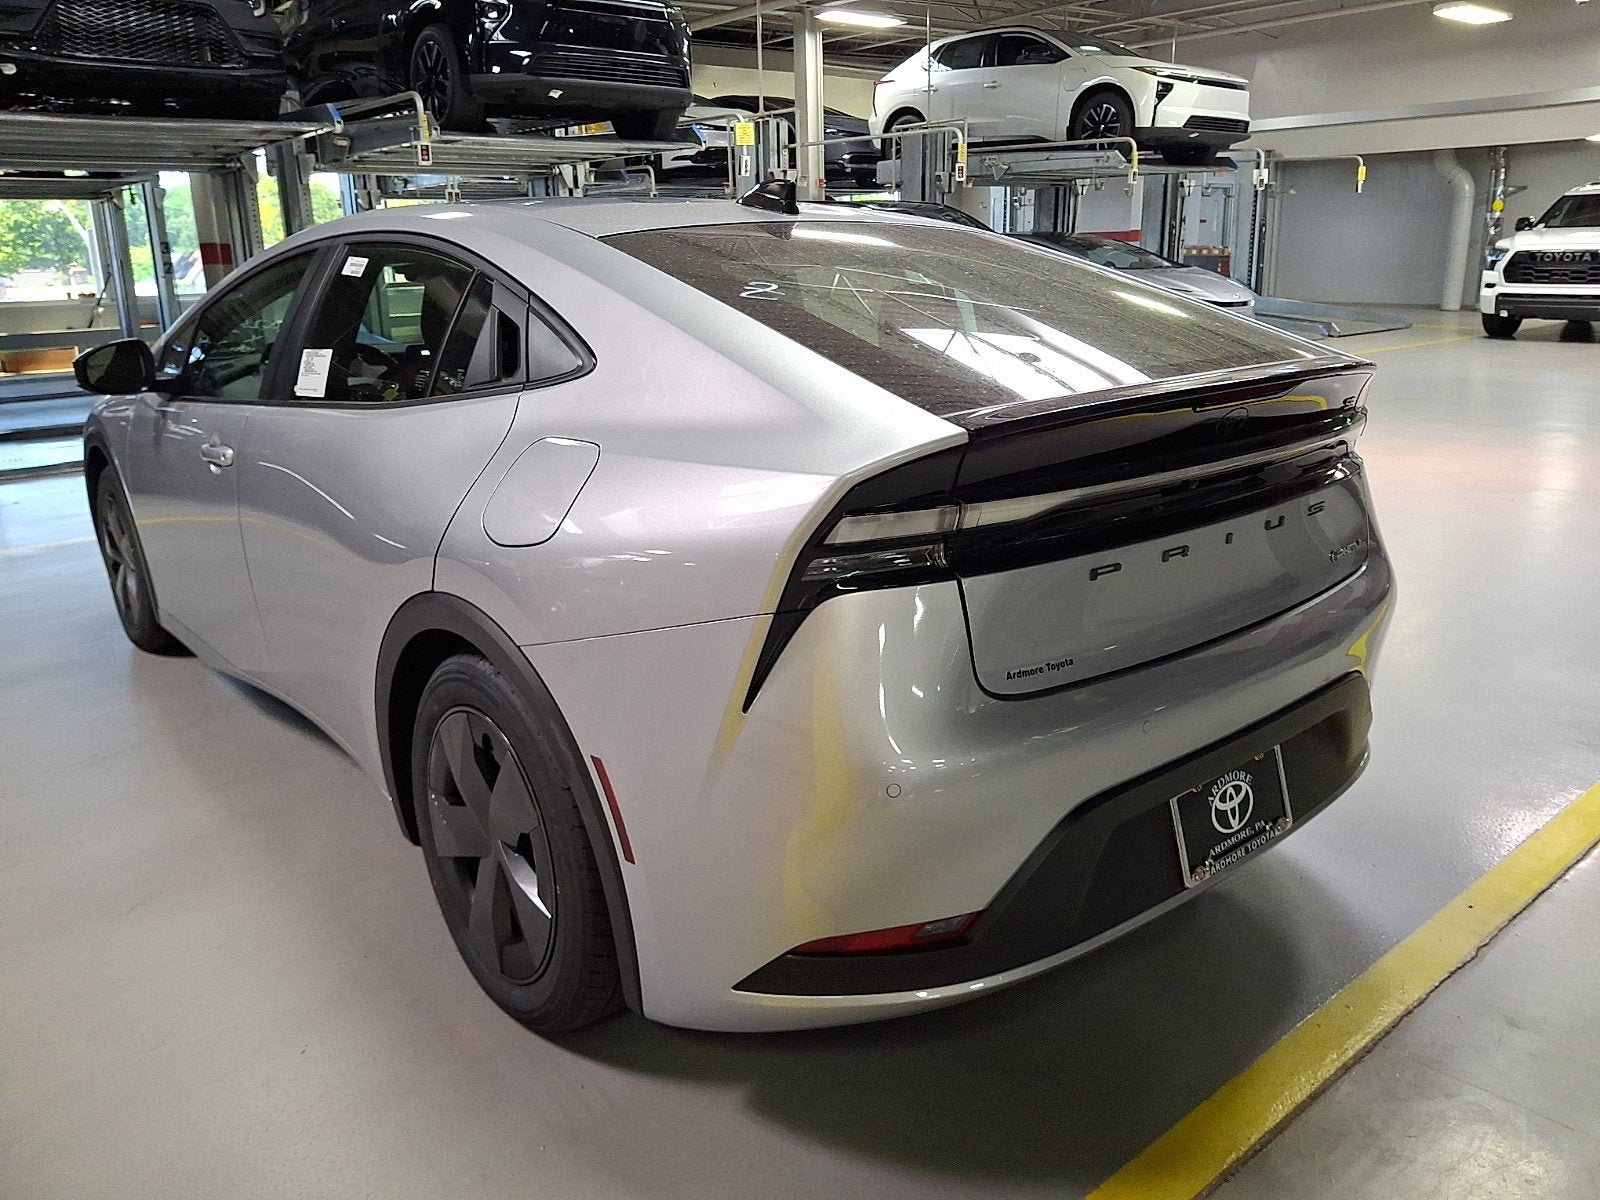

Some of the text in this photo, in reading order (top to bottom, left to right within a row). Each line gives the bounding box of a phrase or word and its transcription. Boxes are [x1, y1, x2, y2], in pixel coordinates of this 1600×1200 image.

[1535, 252, 1592, 262] TOYOTA
[1089, 500, 1326, 582] PRIUS
[1006, 658, 1074, 681] Ardmore Toyota
[1207, 769, 1254, 807] ARDMORE
[1209, 819, 1266, 857] ARDMORE, PA
[1210, 831, 1276, 876] ARDMORE TOYOTA
